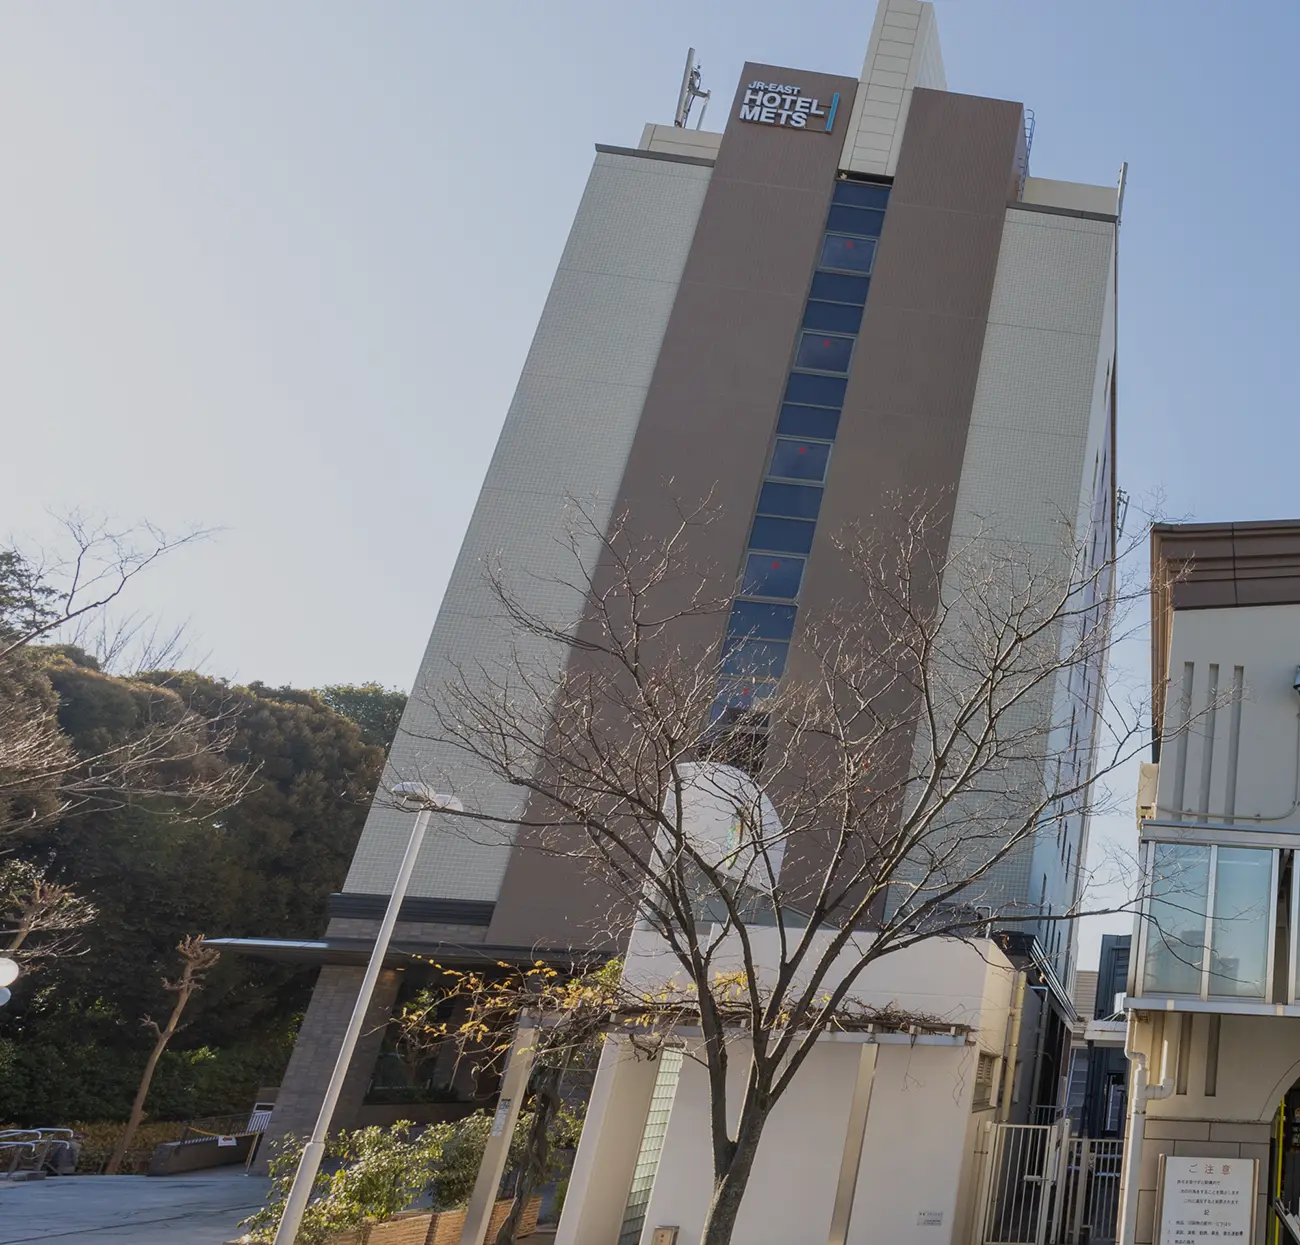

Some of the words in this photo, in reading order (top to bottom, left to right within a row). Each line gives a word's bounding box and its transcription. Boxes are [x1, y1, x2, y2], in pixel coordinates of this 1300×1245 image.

[748, 80, 801, 95] JR-EAST
[743, 89, 825, 116] HOTEL
[739, 105, 808, 128] METS
[1188, 1163, 1232, 1176] ご注意
